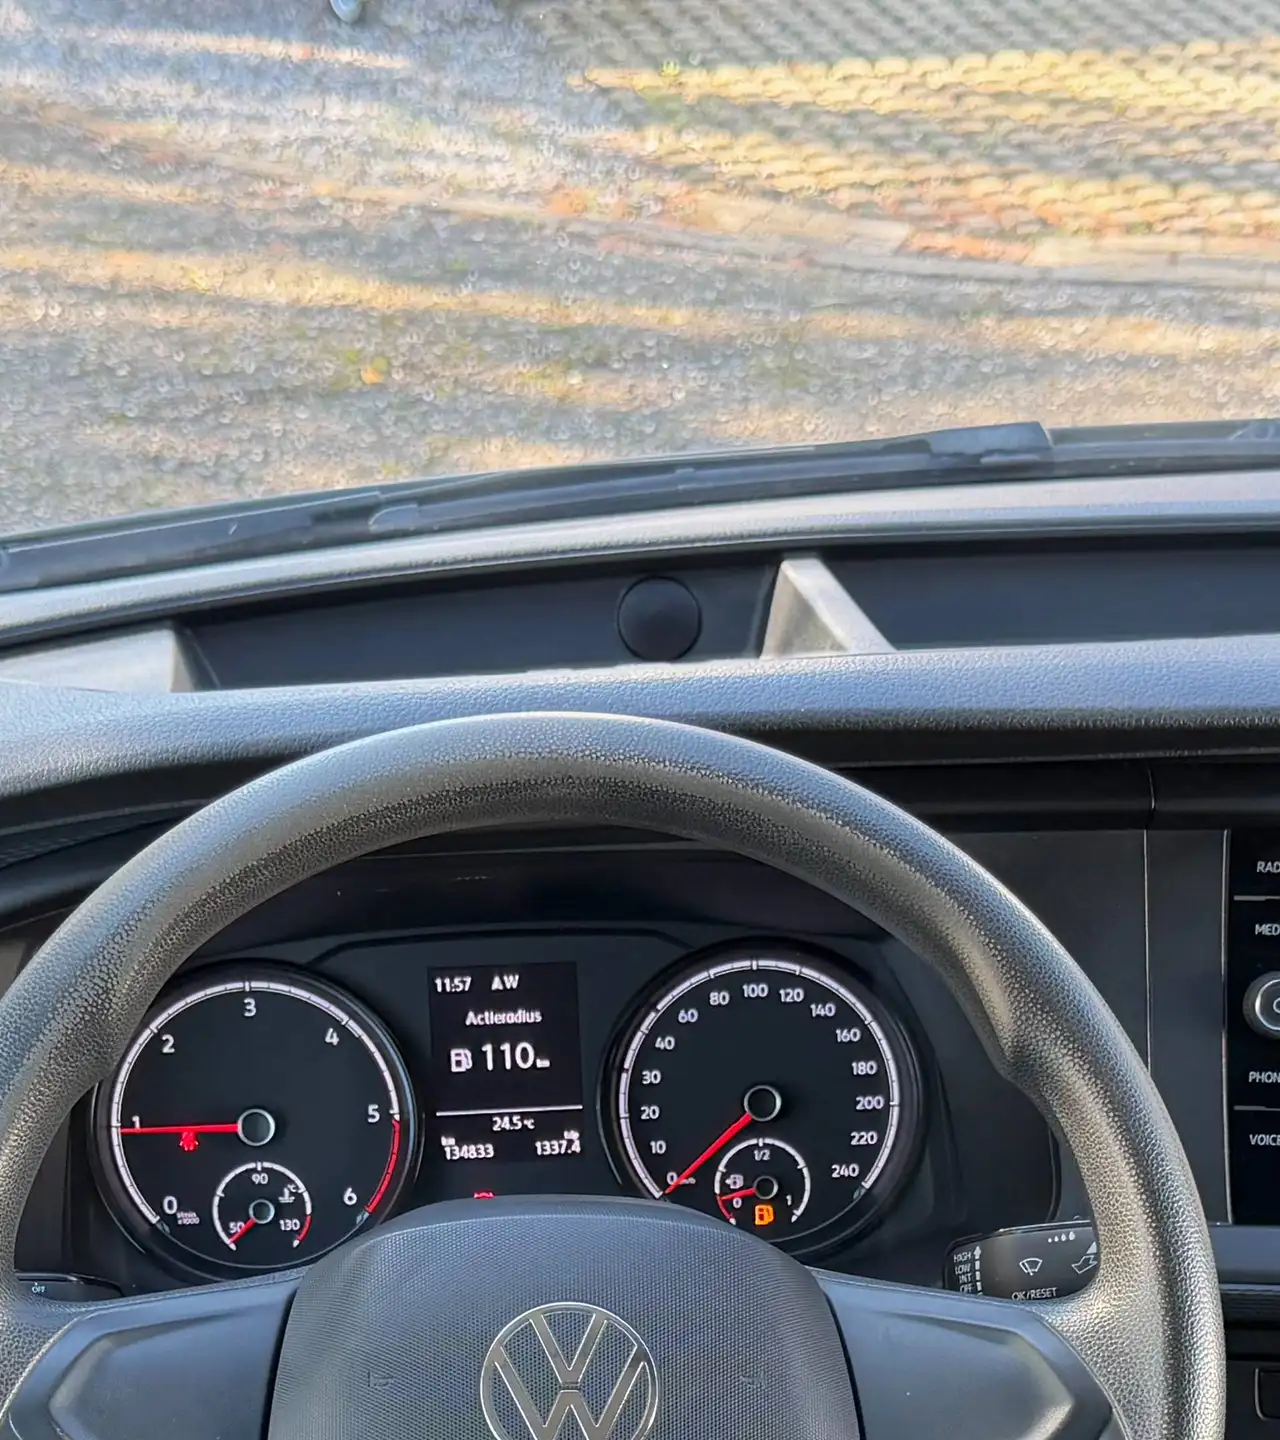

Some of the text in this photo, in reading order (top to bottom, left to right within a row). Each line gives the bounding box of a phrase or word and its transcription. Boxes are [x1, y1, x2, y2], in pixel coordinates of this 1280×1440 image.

[434, 975, 520, 993] 11:57 AW
[742, 983, 769, 998] 100
[709, 991, 730, 1006] 80
[779, 988, 805, 1003] 120
[243, 998, 257, 1018] 3
[810, 1003, 836, 1018] 140
[465, 1009, 543, 1026] Actieradius
[677, 1009, 699, 1024] 60
[324, 1028, 340, 1047] 4
[835, 1028, 861, 1043] 160
[161, 1034, 176, 1054] 2
[655, 1036, 675, 1051] 40
[481, 1041, 535, 1071] 110
[851, 1061, 878, 1076] 180
[641, 1070, 662, 1085] 30
[855, 1096, 885, 1111] 200
[367, 1104, 381, 1123] 5
[640, 1106, 660, 1120] 20
[850, 1131, 878, 1146] 220
[650, 1140, 667, 1155] 10
[754, 1149, 771, 1161] 1/2
[831, 1164, 860, 1178] 240
[251, 1173, 269, 1185] 90
[343, 1187, 358, 1207] 6
[732, 1197, 742, 1209] 0
[786, 1194, 792, 1207] 1
[163, 1196, 178, 1215] 0
[279, 1219, 300, 1231] 130
[953, 1252, 972, 1263] HIGH
[954, 1263, 972, 1274] LOW
[1011, 1287, 1058, 1301] OK/RESET
